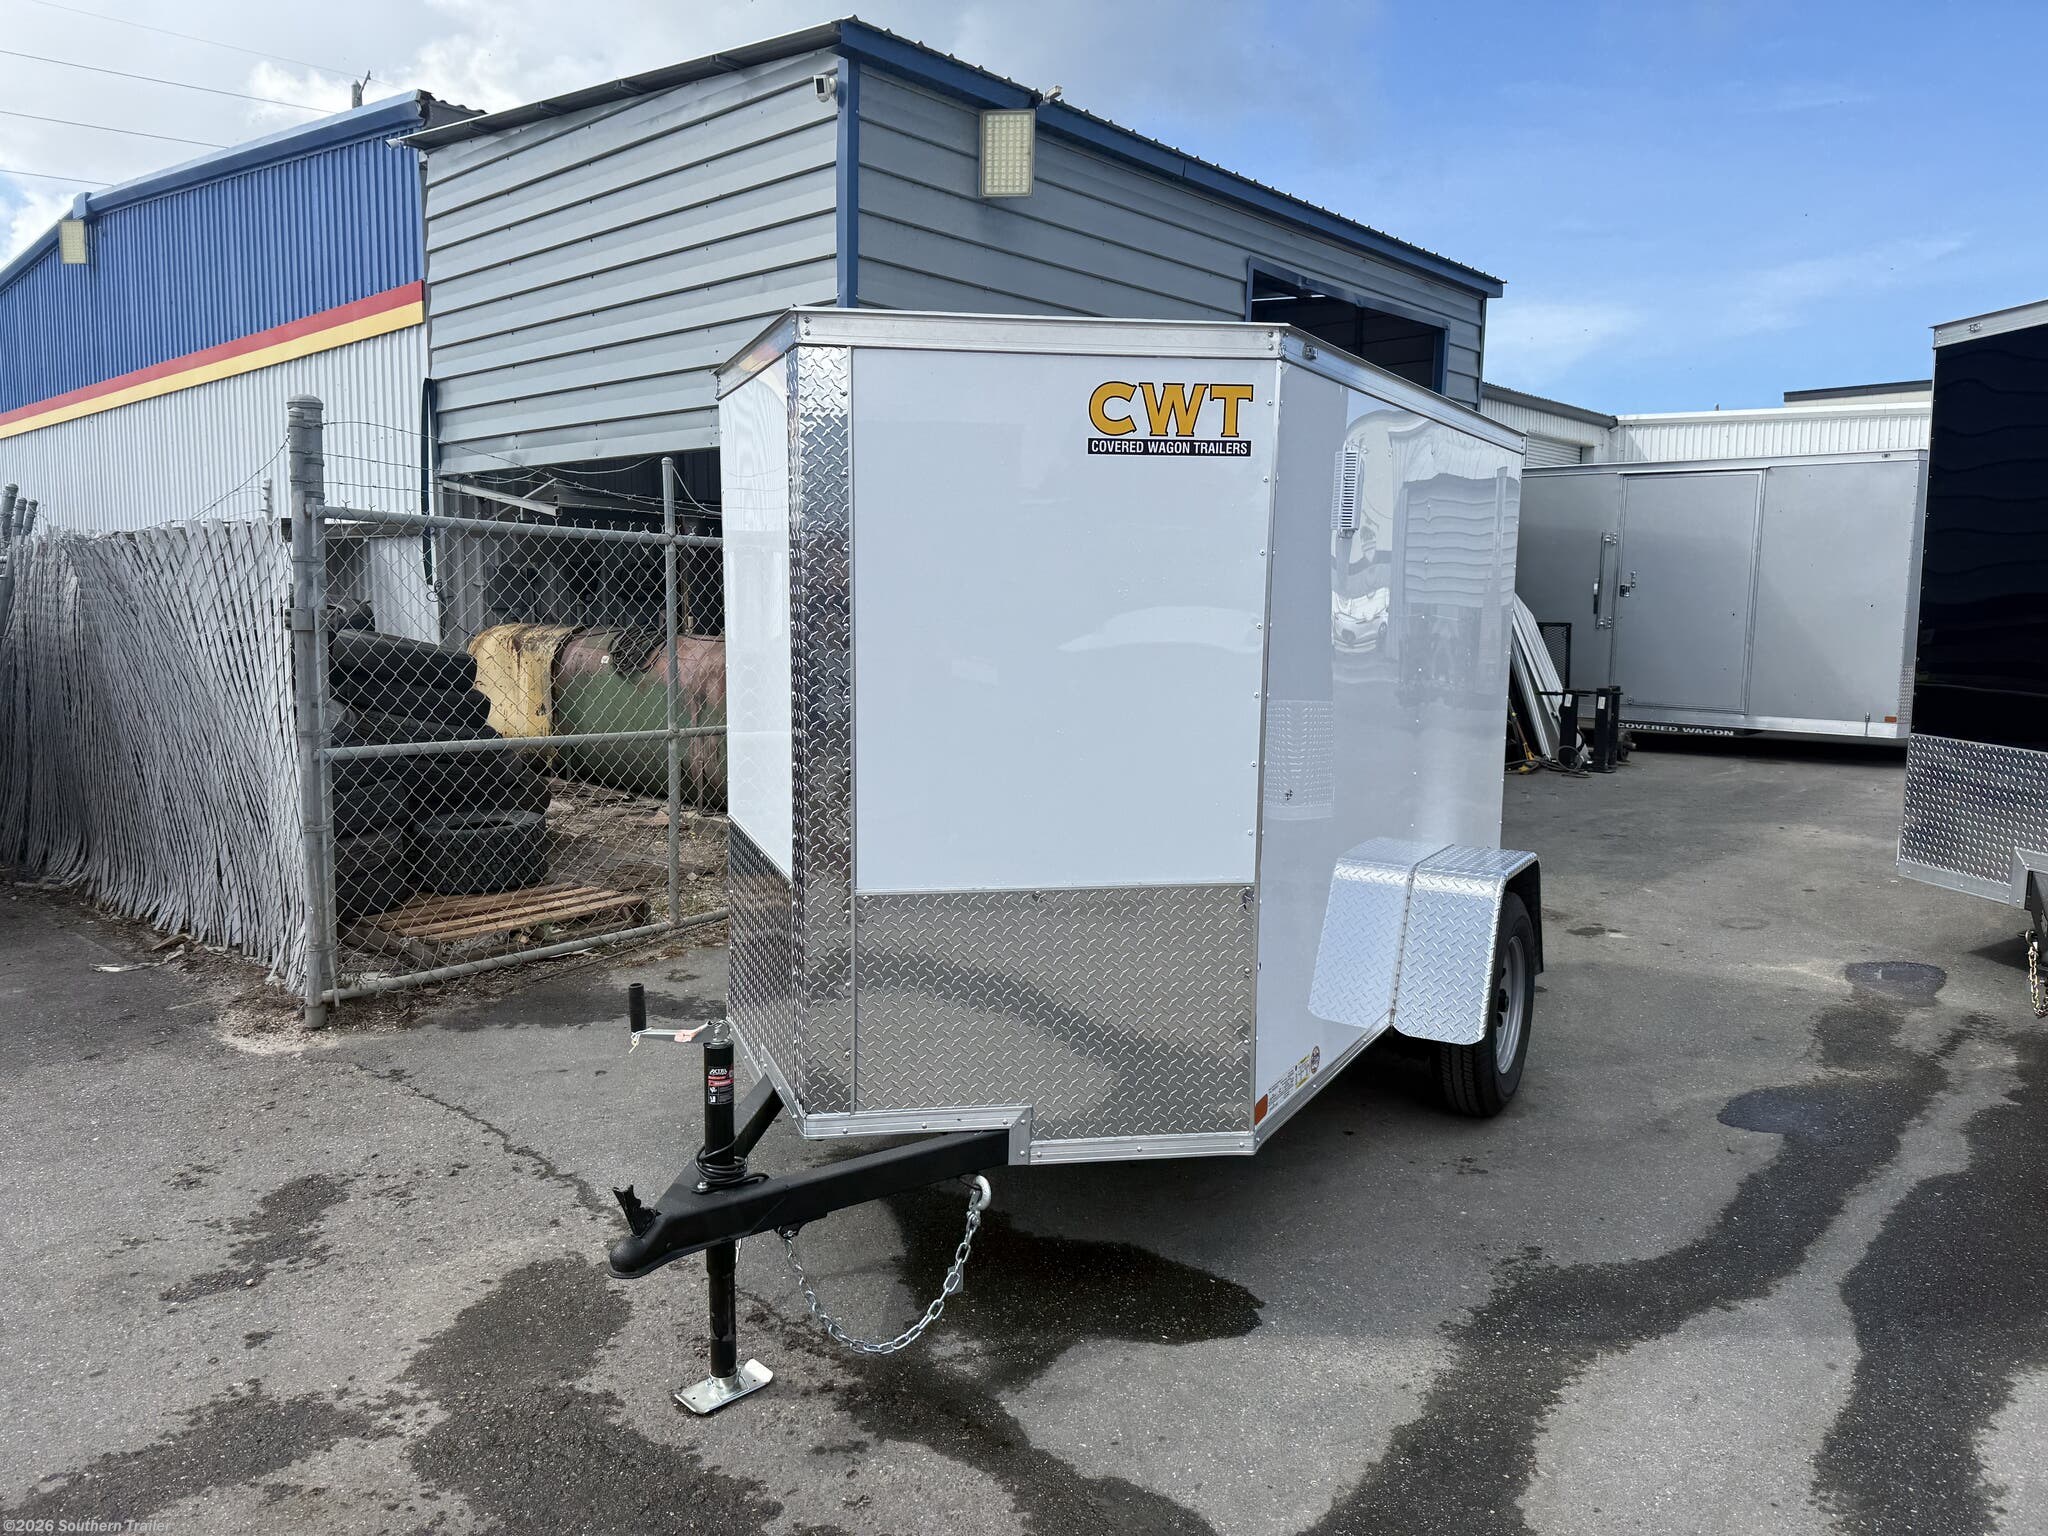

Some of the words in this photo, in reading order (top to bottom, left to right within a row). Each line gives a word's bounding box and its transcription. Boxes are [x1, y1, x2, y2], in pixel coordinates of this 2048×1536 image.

[1088, 381, 1254, 437] CWT
[1091, 440, 1144, 454] COVERED
[1147, 441, 1190, 455] WAGON
[1193, 441, 1248, 455] TRAILERS
[1682, 727, 1735, 736] WAGON
